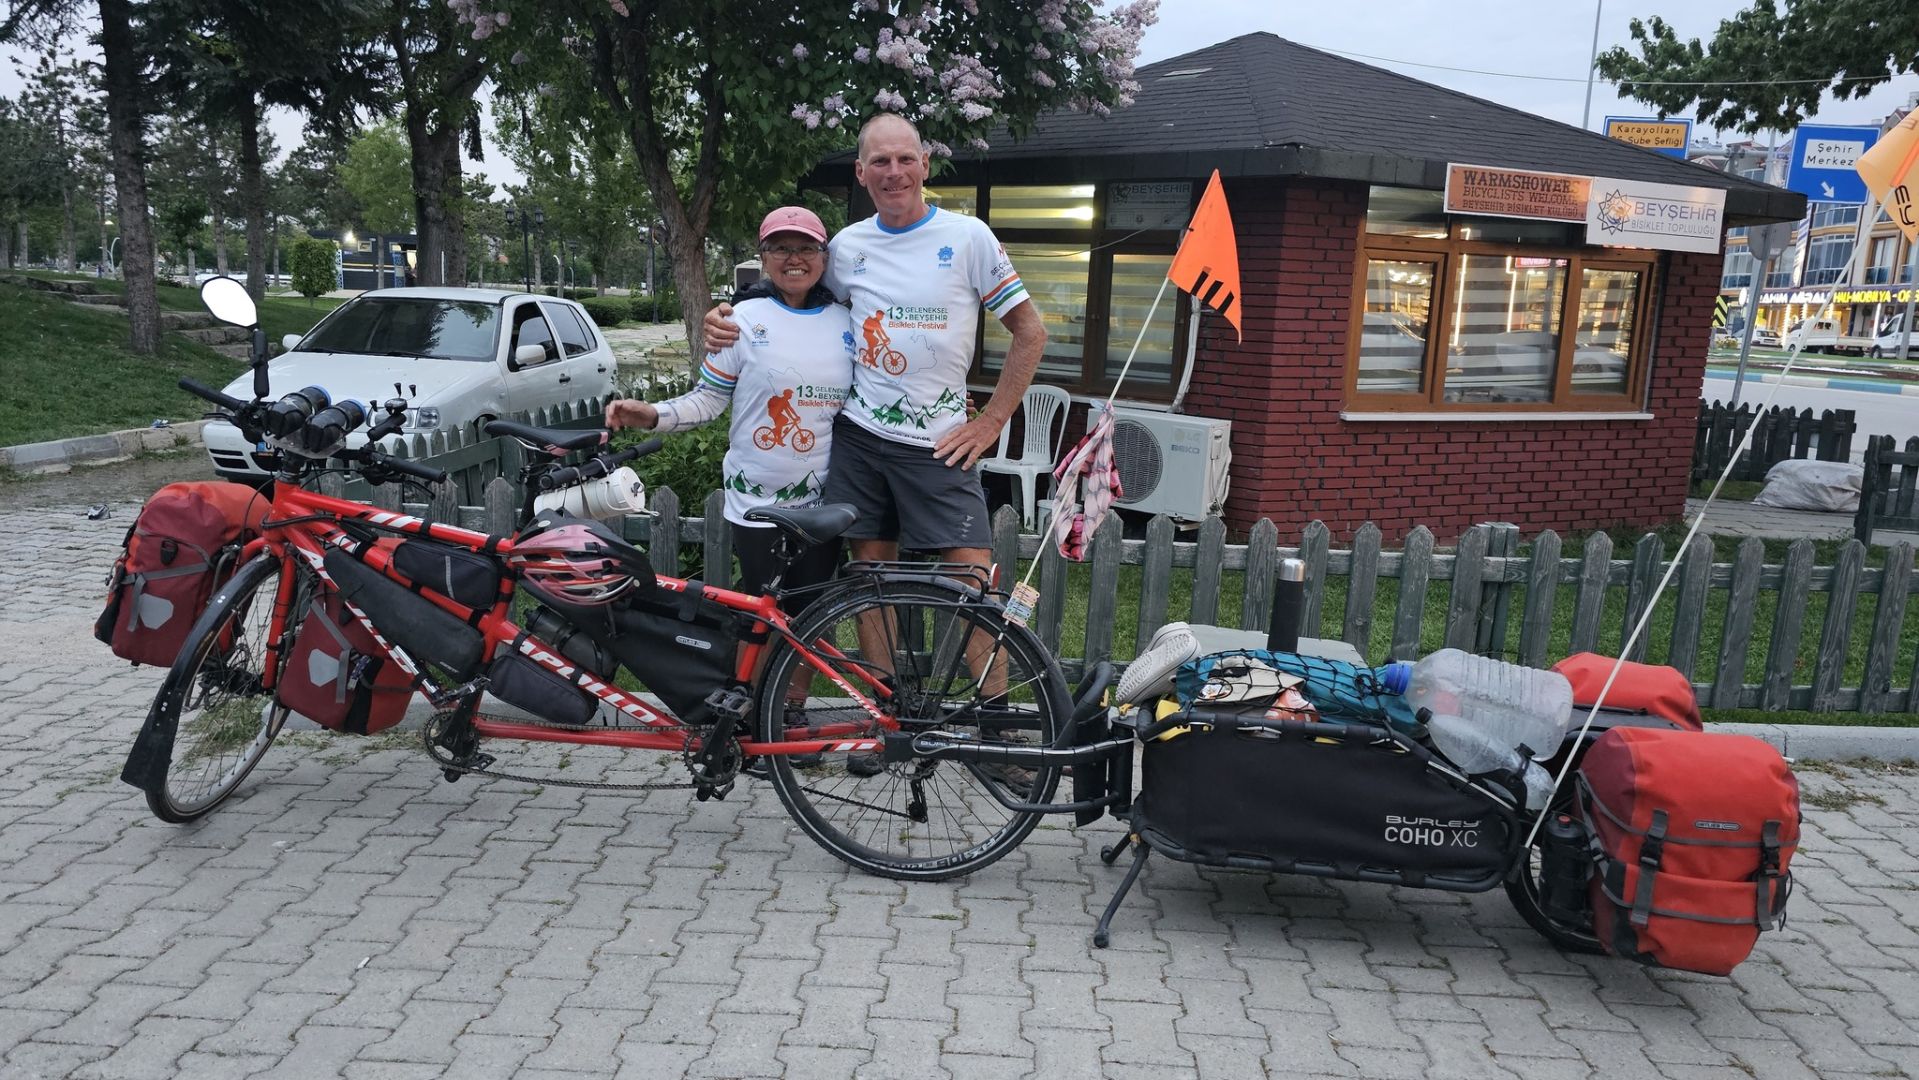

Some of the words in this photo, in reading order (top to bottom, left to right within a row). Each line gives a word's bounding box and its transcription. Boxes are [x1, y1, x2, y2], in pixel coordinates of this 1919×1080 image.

[1616, 124, 1680, 135] Karayolları
[1463, 170, 1580, 194] WARMSHOWERS
[1463, 186, 1525, 201] BICYCLISTS
[1529, 191, 1578, 206] WELCOME
[1634, 201, 1717, 222] BEYŞEHİR
[1668, 222, 1716, 235] TOPLULUĞU
[888, 320, 916, 329] Bisiklet
[917, 321, 948, 330] Festival
[797, 400, 824, 408] Bisiklet
[1385, 815, 1480, 828] BURLEY
[1384, 826, 1445, 847] COHO
[1450, 829, 1479, 848] XC
